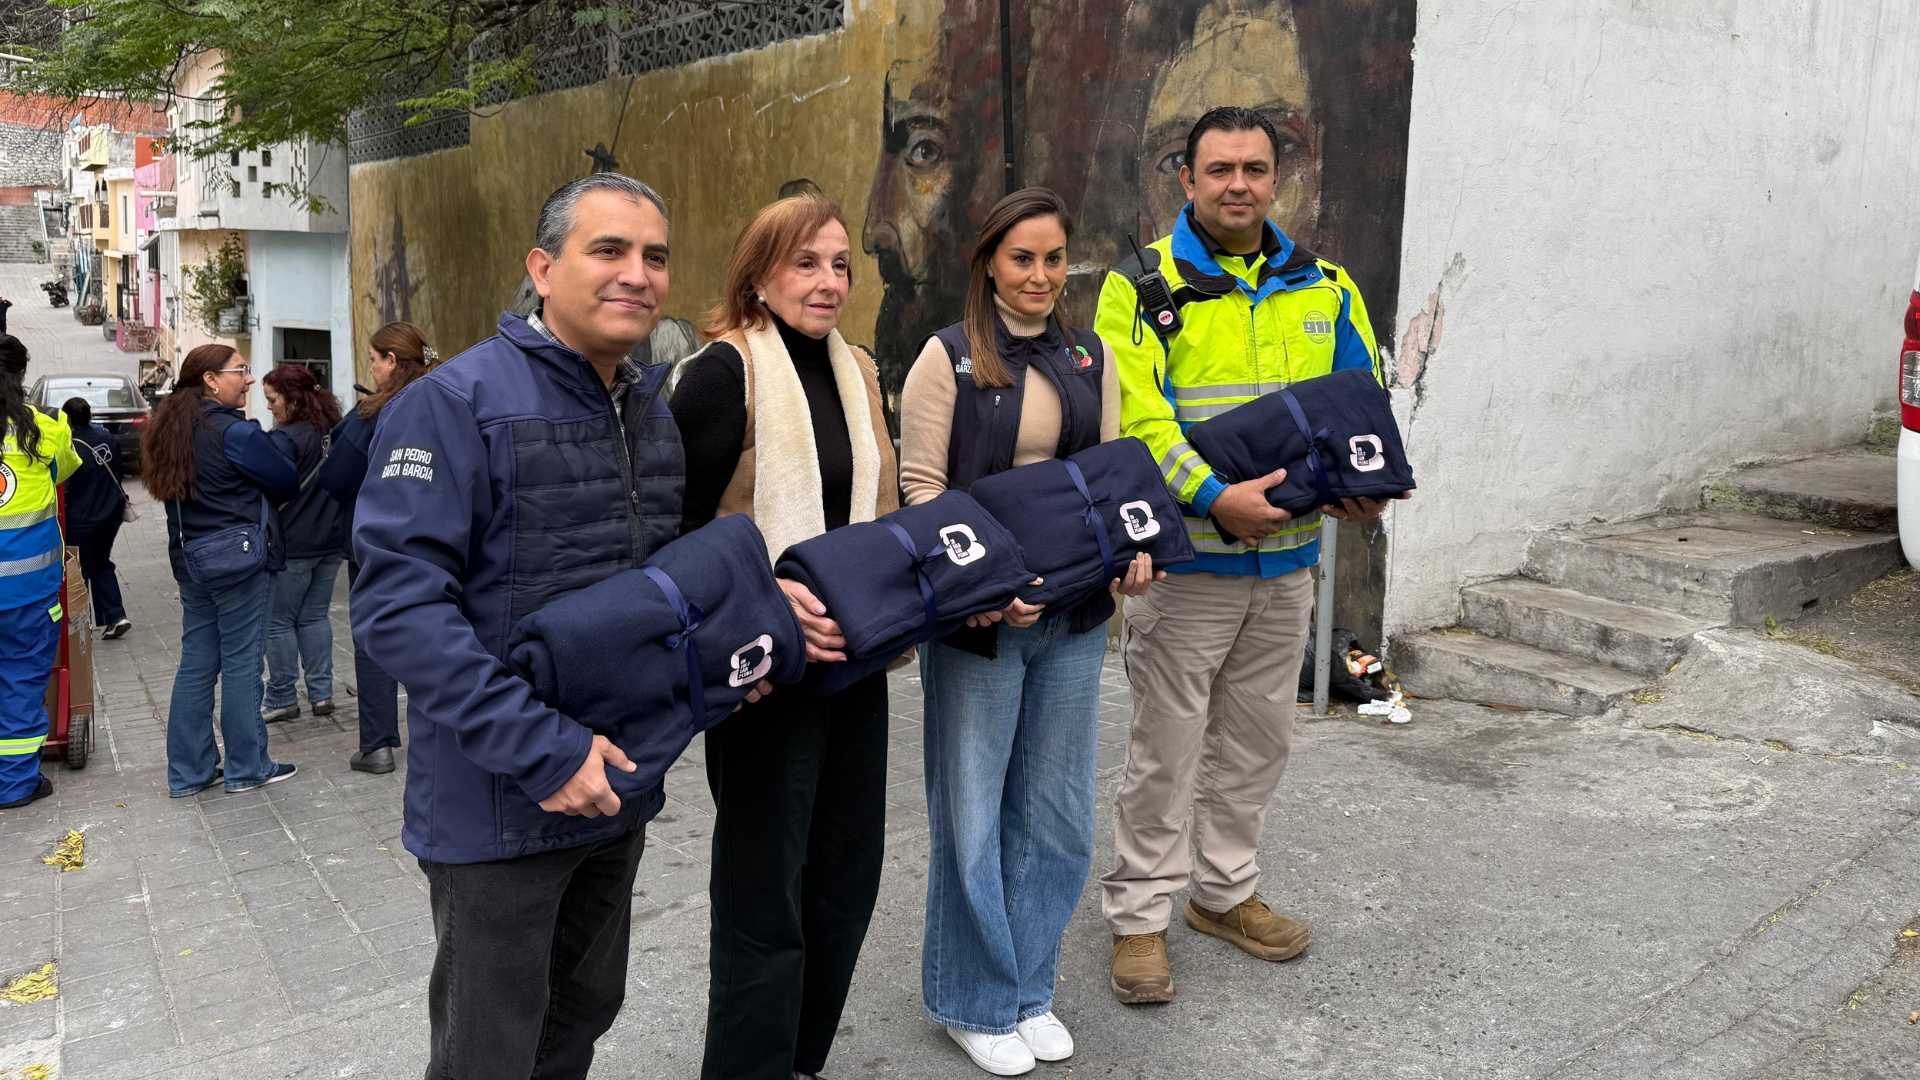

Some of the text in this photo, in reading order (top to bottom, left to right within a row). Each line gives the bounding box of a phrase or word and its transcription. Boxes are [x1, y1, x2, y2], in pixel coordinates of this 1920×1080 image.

[1303, 321, 1331, 334] 911
[955, 364, 973, 374] GARZ
[390, 448, 432, 464] SAN PEDRO
